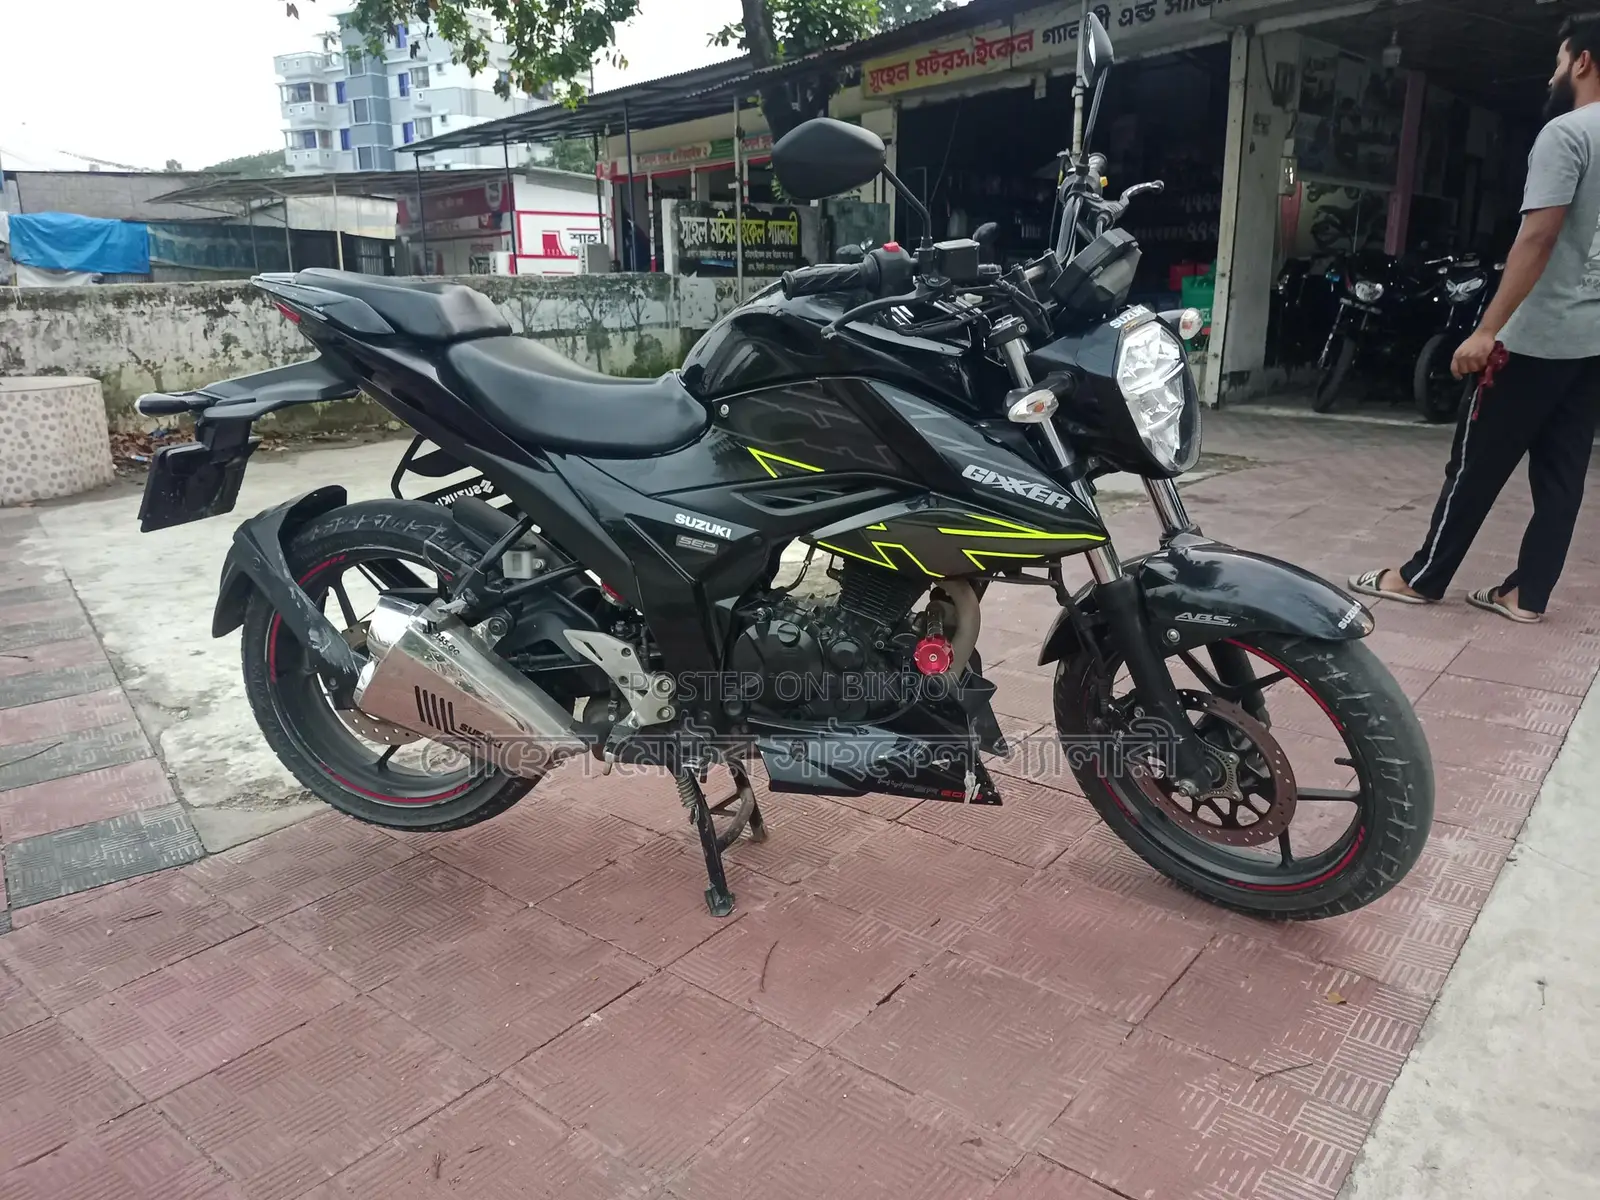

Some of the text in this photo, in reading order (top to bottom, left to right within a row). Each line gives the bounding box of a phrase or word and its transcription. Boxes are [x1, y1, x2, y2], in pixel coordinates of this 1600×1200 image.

[709, 210, 765, 247] মটরইকেল
[961, 464, 1071, 510] GIXXER
[674, 513, 732, 539] SUZUKI
[1174, 611, 1233, 625] ABS
[1338, 600, 1361, 630] SUZU
